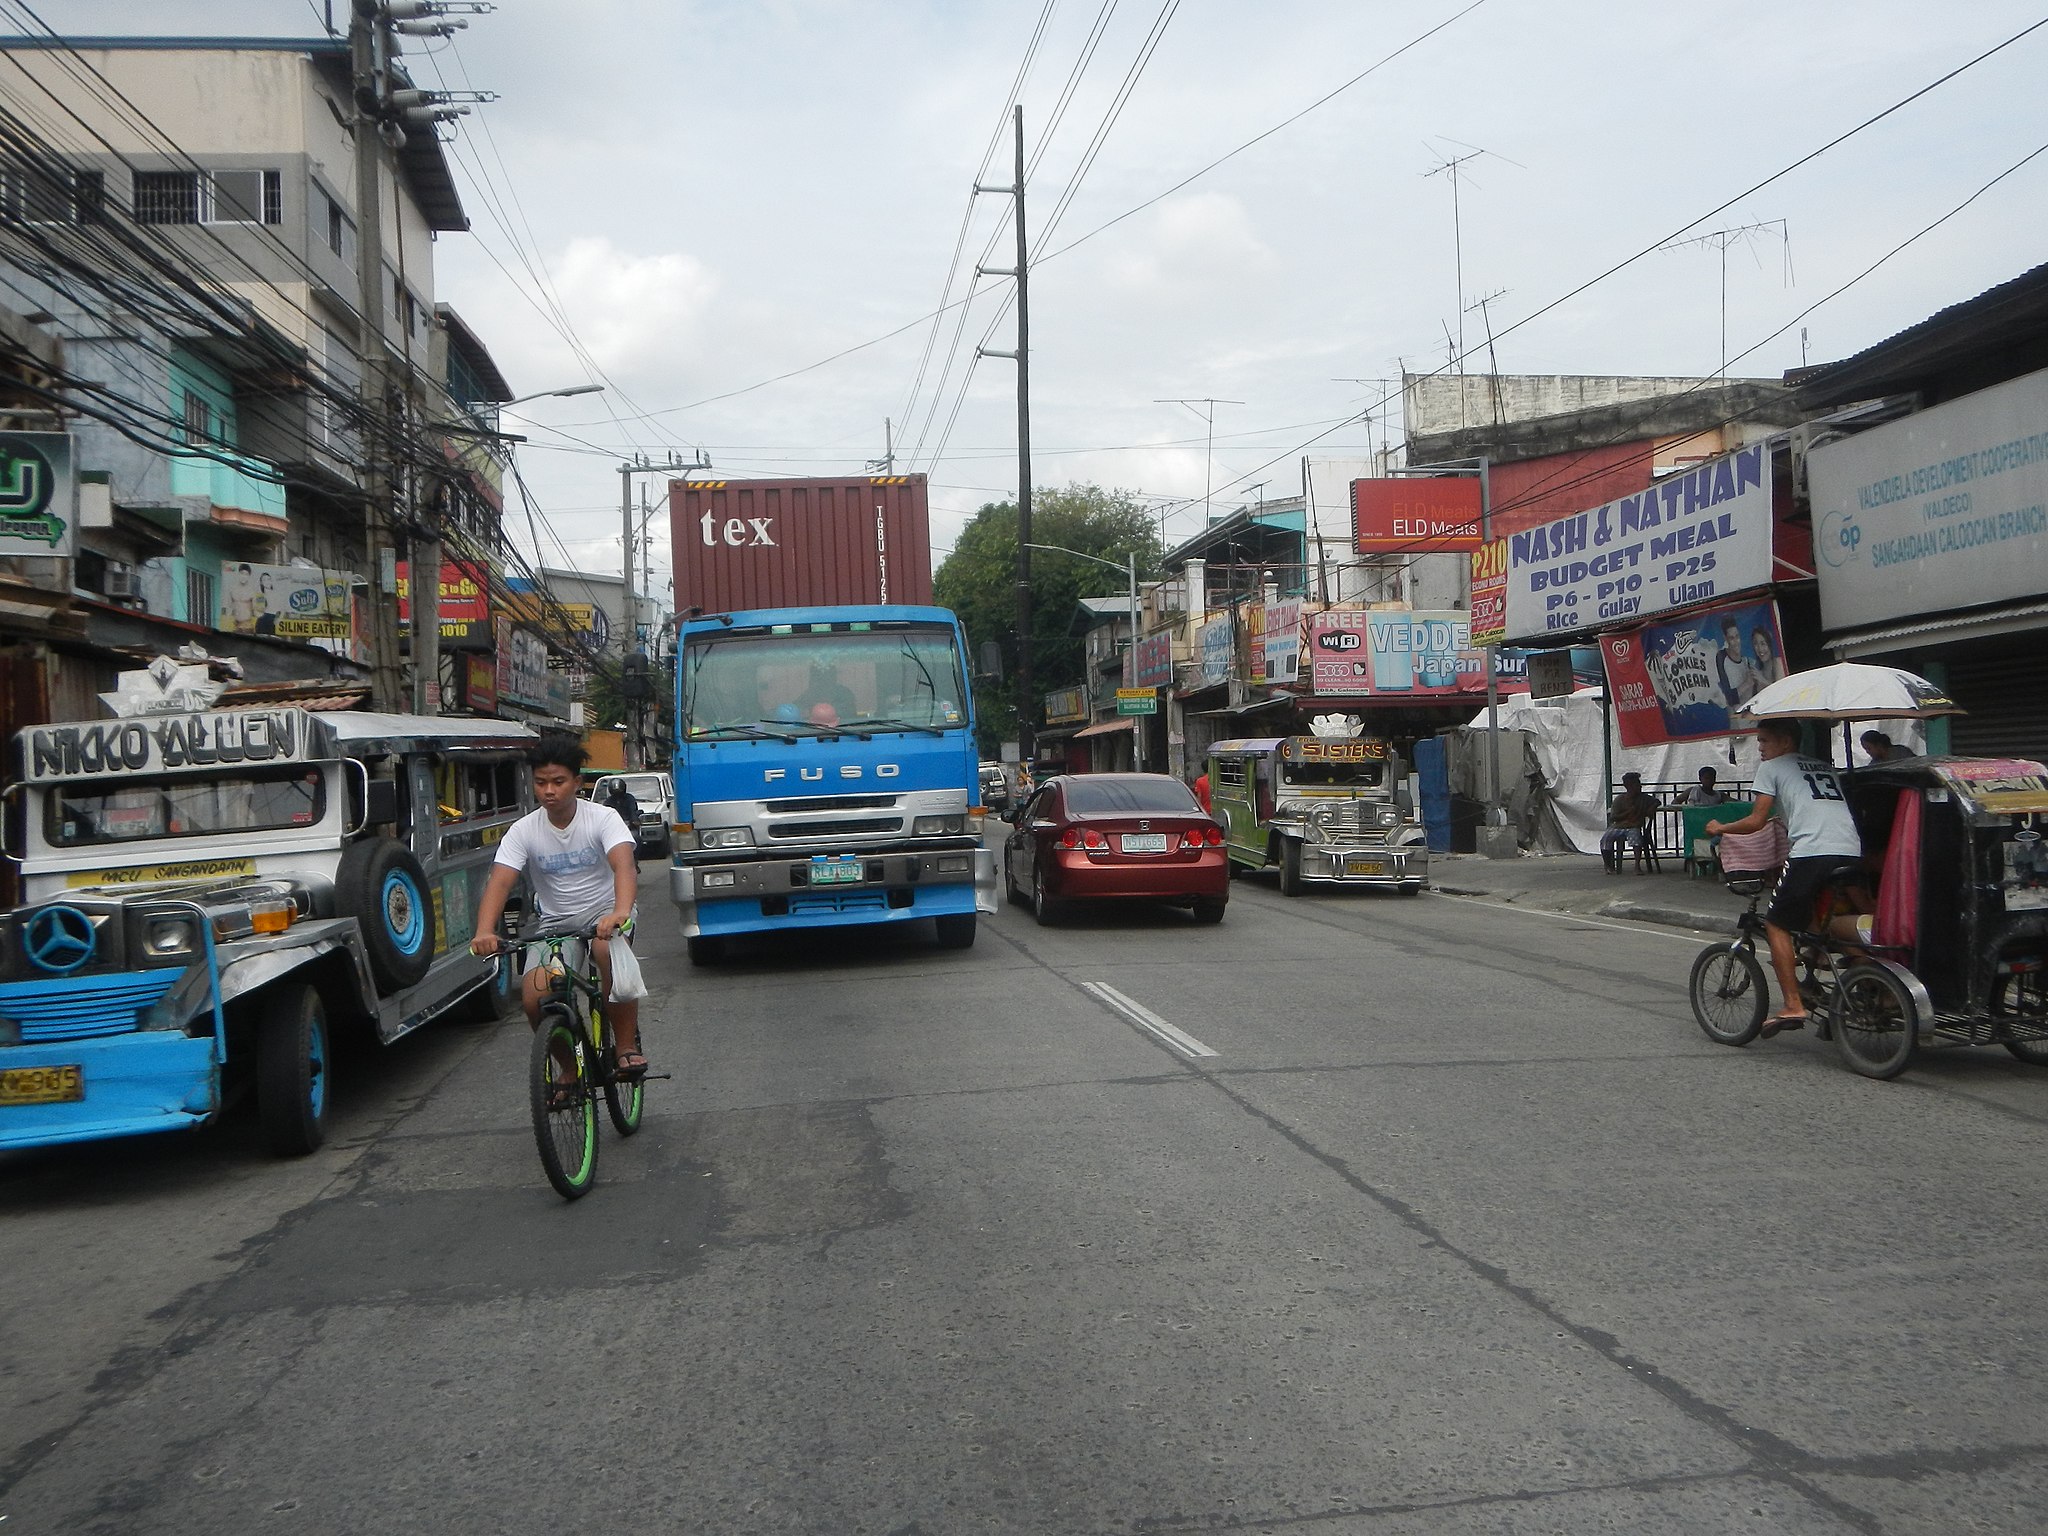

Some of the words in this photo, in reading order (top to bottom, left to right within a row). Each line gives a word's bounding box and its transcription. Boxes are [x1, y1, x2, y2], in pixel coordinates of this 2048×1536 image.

[1857, 472, 1912, 510] VALENZUELA
[1912, 452, 1978, 496] DEVELOPMENT
[1512, 513, 1589, 568] NASH
[1593, 506, 1613, 546] &
[1620, 445, 1762, 537] NATHAN
[1923, 491, 1973, 525] (VALDECO)
[700, 508, 776, 547] tex
[876, 505, 885, 551] TGBU
[1393, 519, 1427, 536] ELD
[1431, 521, 1478, 536] Meats
[1871, 530, 1938, 568] SANGANDAAN
[1938, 515, 1997, 553] CALOOCAN
[1999, 502, 2048, 541] BRANCH
[1471, 538, 1508, 579] P210
[1530, 542, 1643, 592] BUDGET
[1650, 512, 1738, 561] MEAL
[1546, 590, 1578, 611] P6
[1597, 573, 1643, 600] P10
[1666, 551, 1717, 582] P25
[292, 591, 318, 608] Sulit
[1546, 610, 1579, 630] Rice
[1598, 595, 1642, 619] Gulay
[1669, 578, 1715, 605] Ulam
[278, 620, 310, 635] SILINE
[311, 621, 347, 636] EATERY
[1315, 613, 1364, 629] FREE
[1368, 622, 1487, 654] VEDDE
[1411, 654, 1482, 678] Japan
[1662, 655, 1707, 683] COOKIES
[1540, 682, 1568, 694] RENT
[1618, 682, 1644, 701] SARAP
[1673, 673, 1711, 696] DREAM
[32, 722, 150, 779] NIKKO
[1301, 742, 1384, 759] SISTERS
[764, 763, 900, 783] FUSO
[1803, 773, 1845, 801] 13
[1146, 836, 1164, 846] 665
[814, 864, 834, 877] RLA
